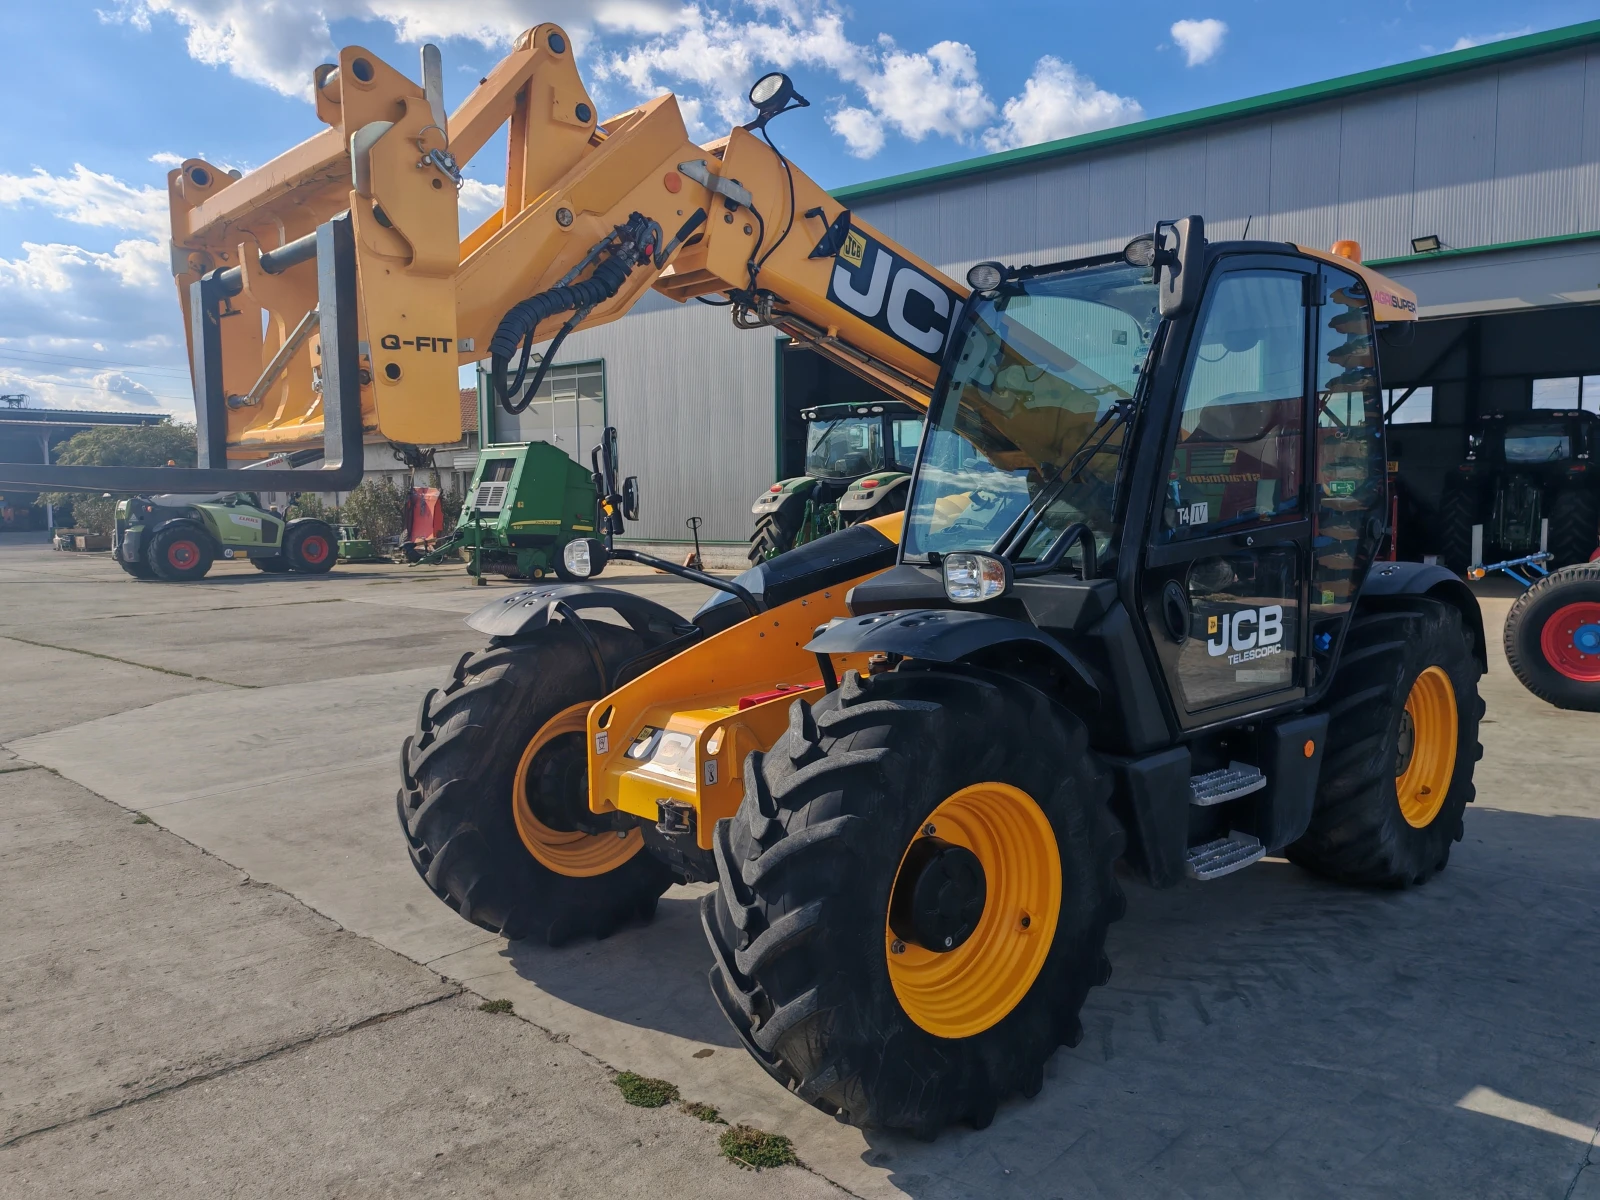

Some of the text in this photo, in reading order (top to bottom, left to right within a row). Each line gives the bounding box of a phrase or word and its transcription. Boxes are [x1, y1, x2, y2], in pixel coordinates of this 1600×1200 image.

[845, 236, 861, 258] JCB
[381, 334, 452, 353] Q-FIT
[1207, 605, 1283, 656] JCB
[1228, 644, 1281, 665] TELESCOPIC
